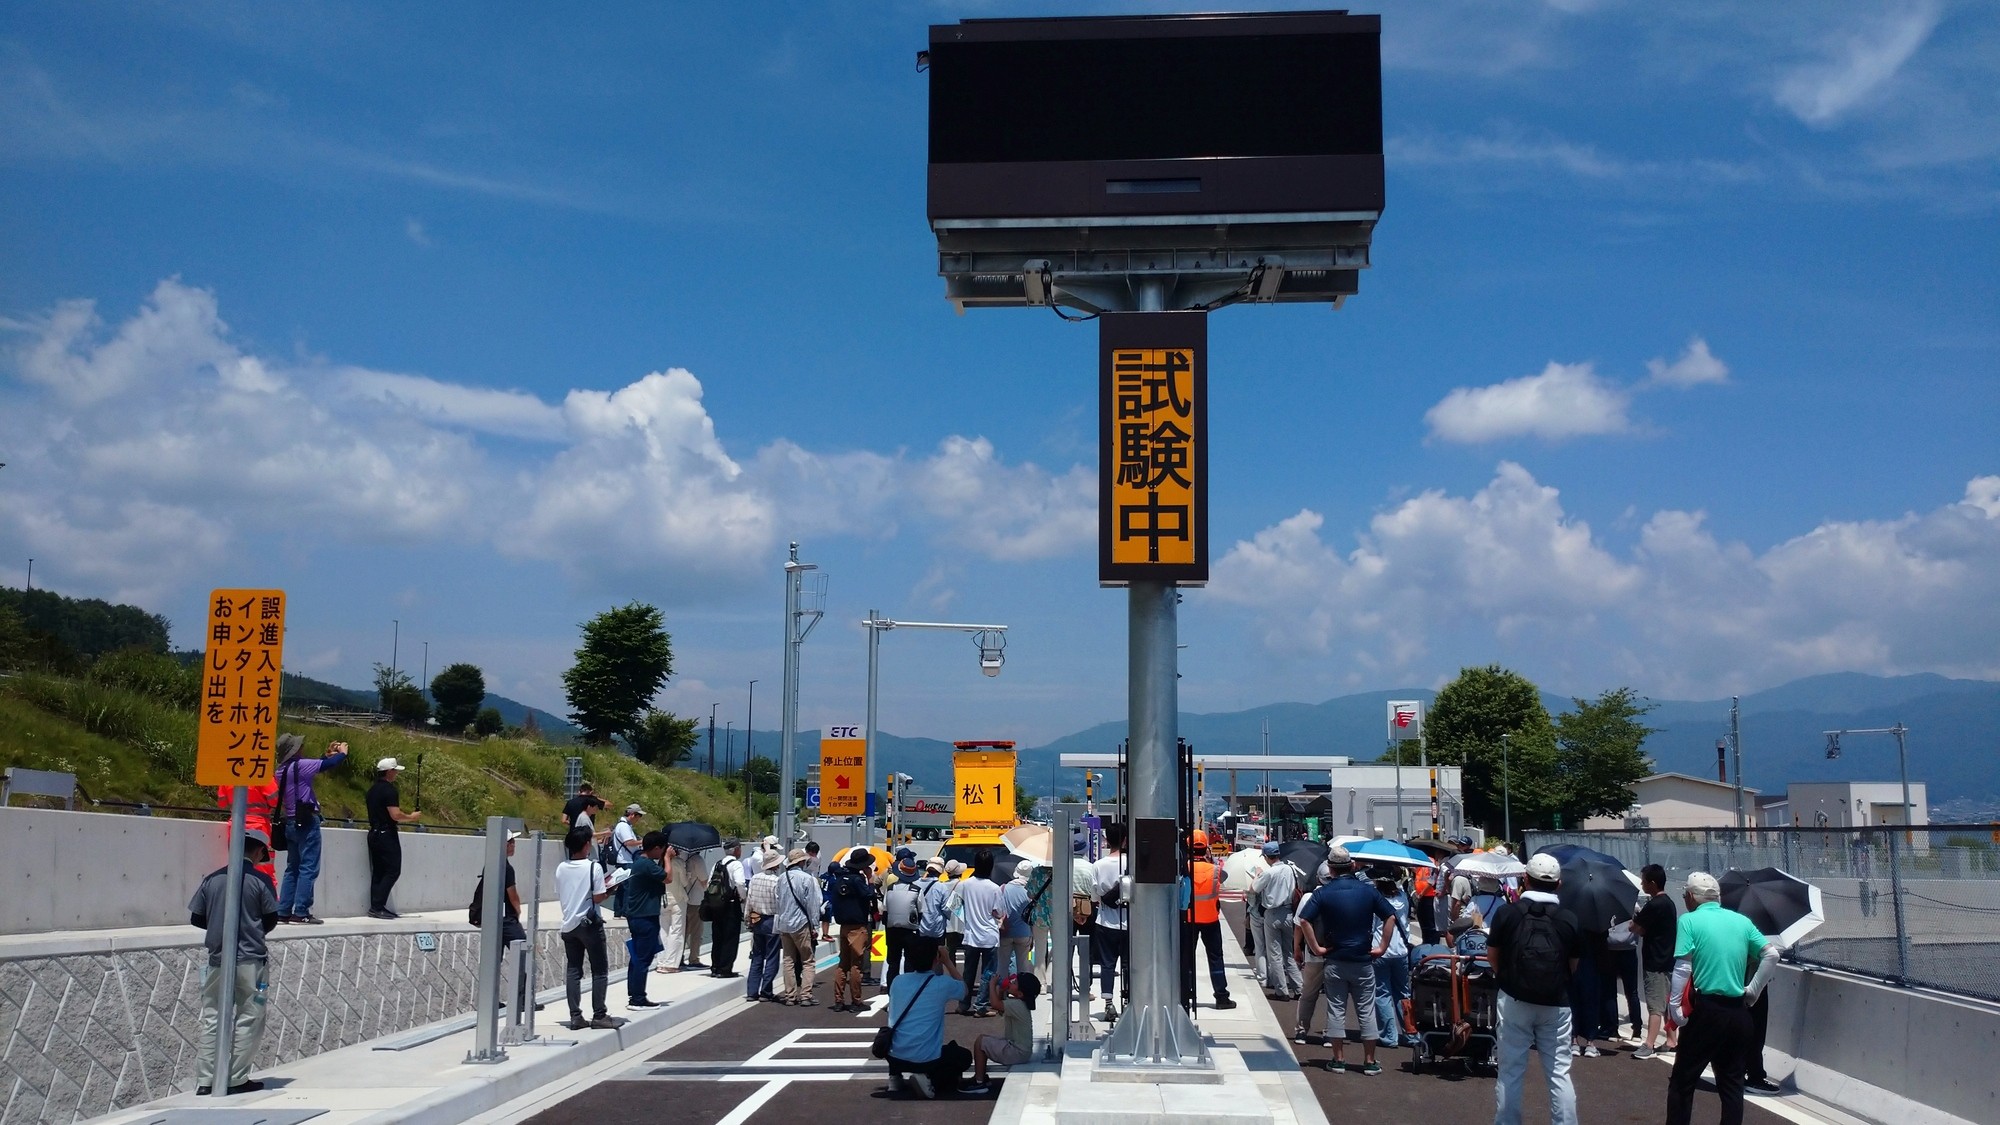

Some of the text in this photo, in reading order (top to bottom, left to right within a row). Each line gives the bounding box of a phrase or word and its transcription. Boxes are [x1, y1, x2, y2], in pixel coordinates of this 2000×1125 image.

[1115, 351, 1192, 562] 試験中
[206, 596, 234, 724] お申し出を
[226, 597, 256, 778] インターホンで
[248, 596, 281, 779] 誤進入された方
[823, 756, 863, 767] 停止位置
[830, 726, 858, 738] ETC
[962, 783, 1001, 805] 松 1
